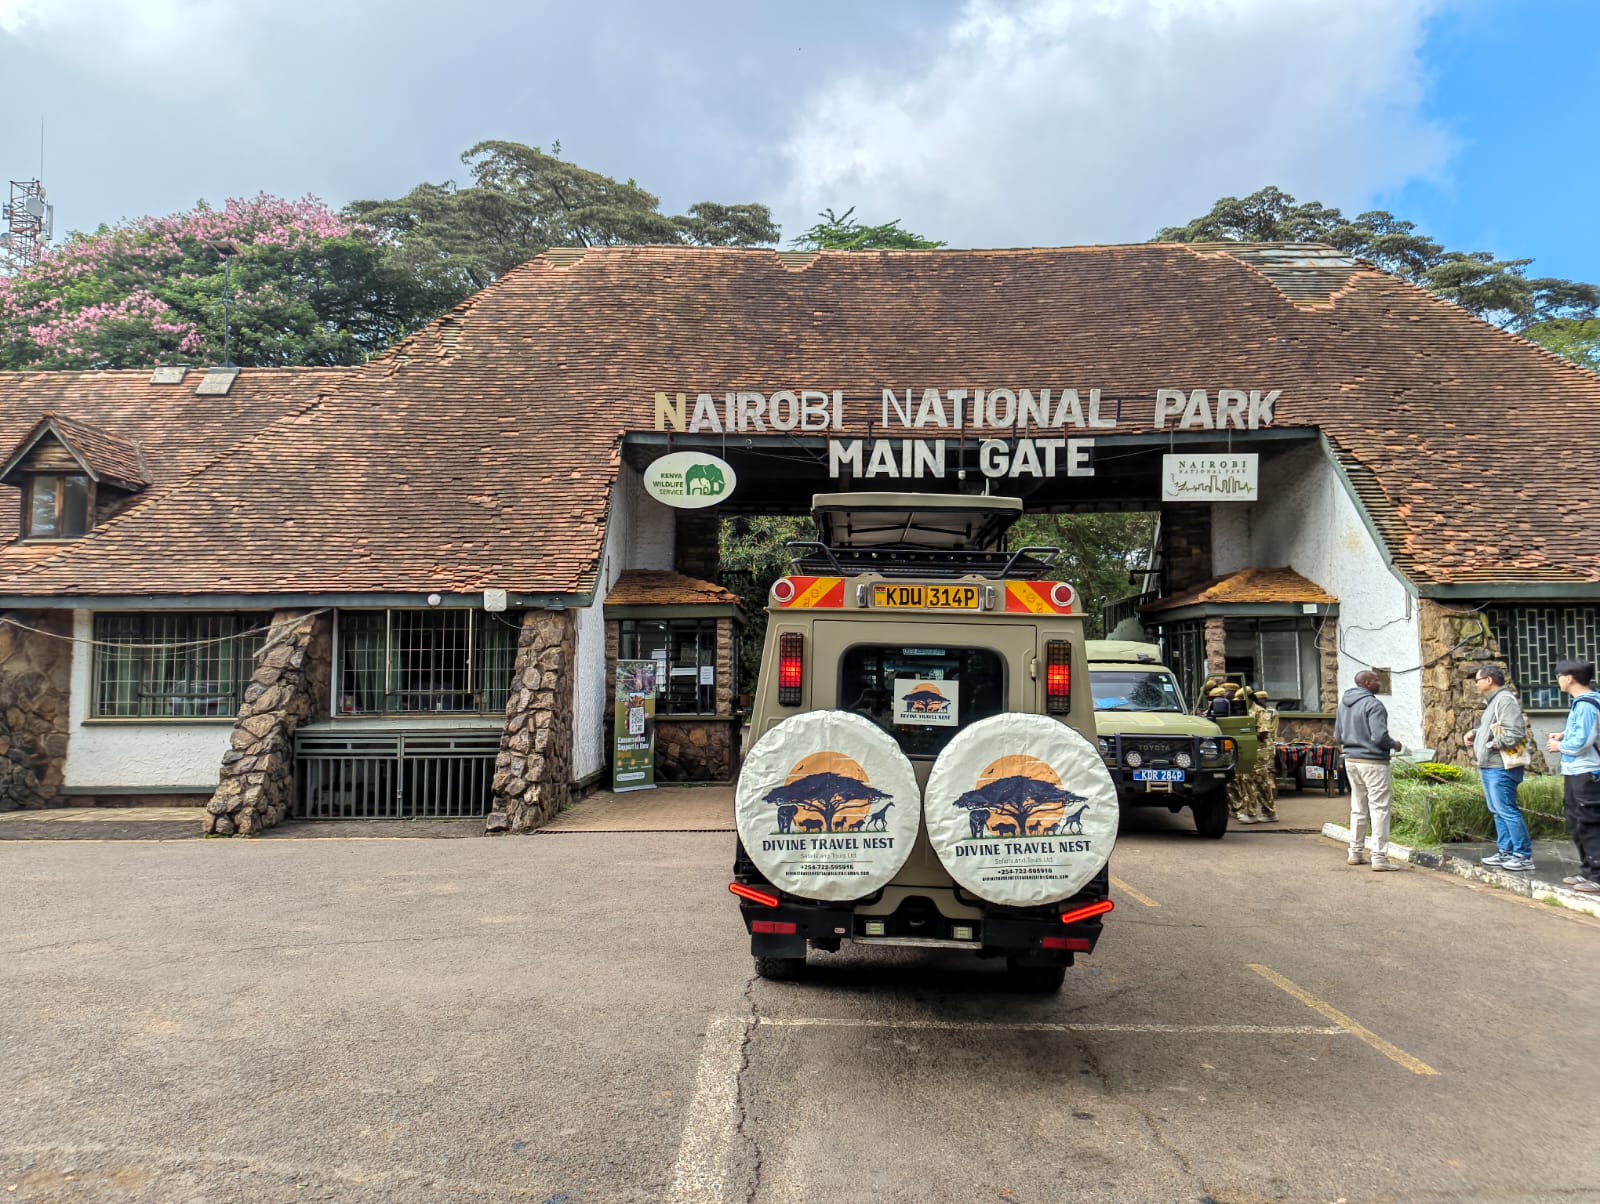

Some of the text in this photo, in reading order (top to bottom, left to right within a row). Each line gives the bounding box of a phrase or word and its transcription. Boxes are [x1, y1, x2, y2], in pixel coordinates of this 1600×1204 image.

[655, 388, 1283, 433] NAIROBI NATIONAL PARK
[829, 438, 1096, 478] MAIN GATE
[1179, 460, 1246, 469] NAIROBI
[886, 587, 975, 607] KDU 314P
[1141, 770, 1182, 780] KDR 284P
[762, 837, 895, 852] DIVINE TRAVEL NEST
[955, 840, 1092, 857] DIVINE TRAVEL NEST
